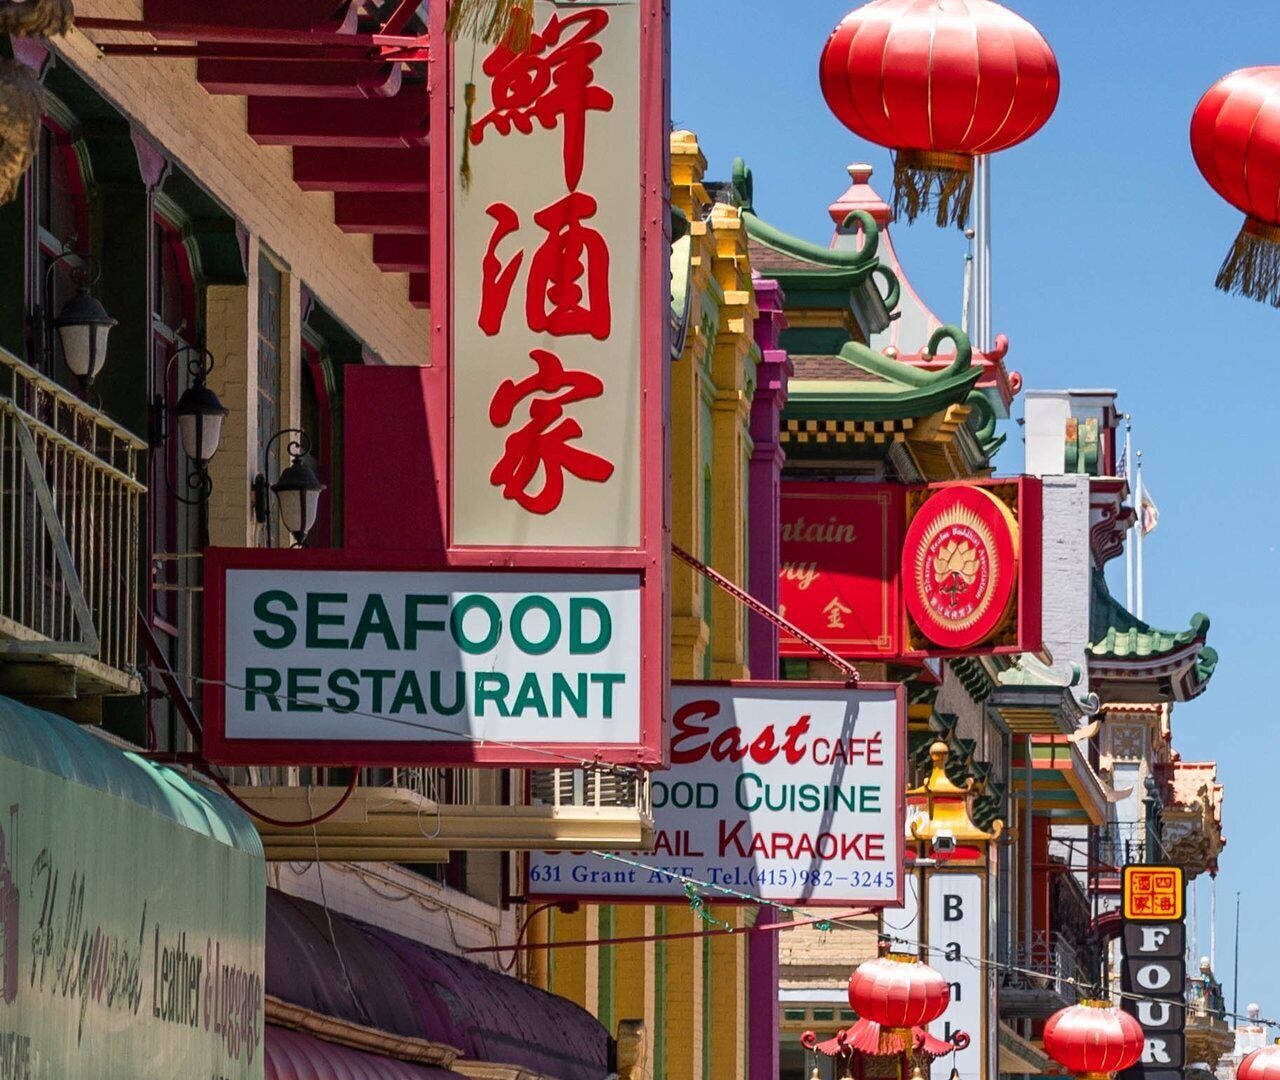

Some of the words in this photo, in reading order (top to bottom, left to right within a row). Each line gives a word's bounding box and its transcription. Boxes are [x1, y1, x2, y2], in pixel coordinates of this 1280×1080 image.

[252, 590, 613, 656] SEAFOOD
[243, 668, 626, 720] RESTAURANT
[669, 699, 812, 766] East
[812, 732, 884, 766] CAFÉ
[530, 865, 562, 883] 631
[572, 865, 636, 884] Grant
[649, 866, 694, 885] AVE
[30, 848, 148, 1049] Hollywood
[152, 921, 202, 1028] Leather
[213, 941, 262, 1066] Luggage
[942, 894, 966, 1044] Bank
[1136, 926, 1173, 1065] FOUR
